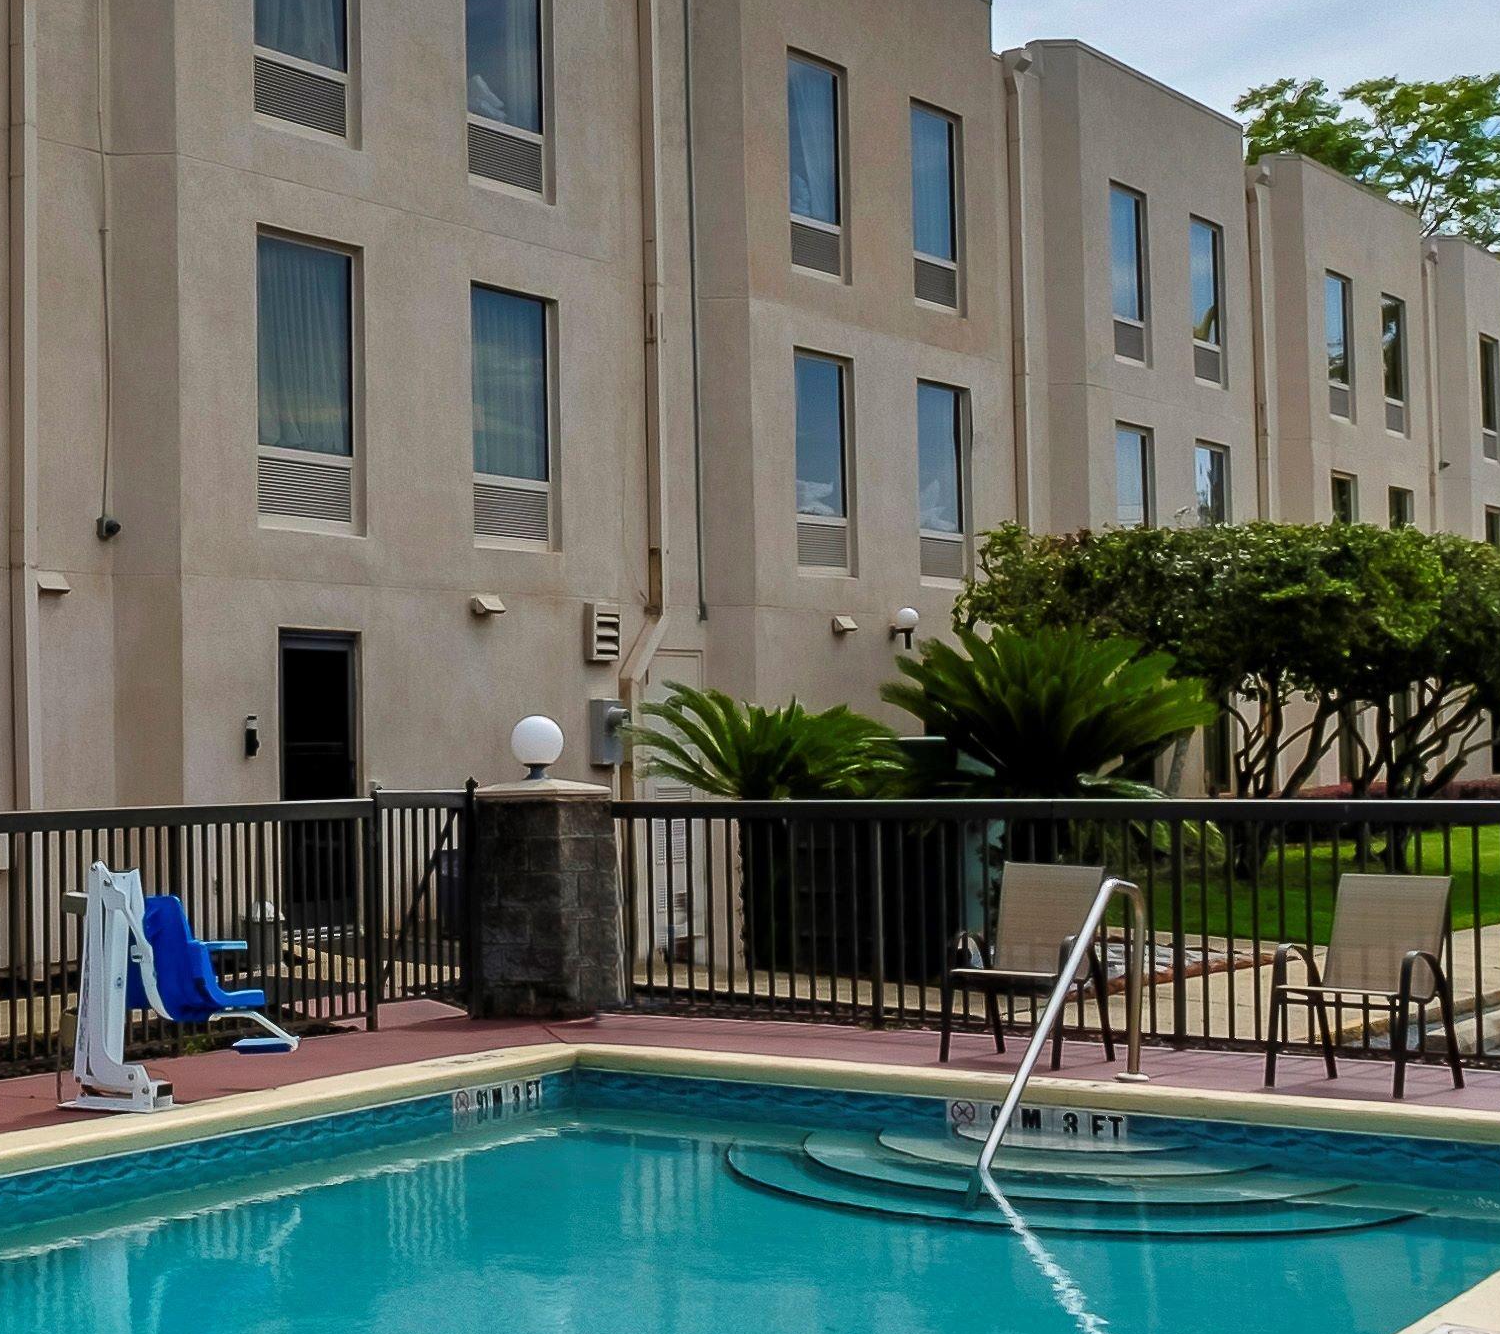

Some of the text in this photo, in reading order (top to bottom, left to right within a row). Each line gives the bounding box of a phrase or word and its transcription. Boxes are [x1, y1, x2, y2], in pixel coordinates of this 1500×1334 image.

[526, 1080, 540, 1104] FT
[1021, 1108, 1042, 1130] M
[1062, 1112, 1078, 1133] 3
[1091, 1114, 1124, 1139] FT
